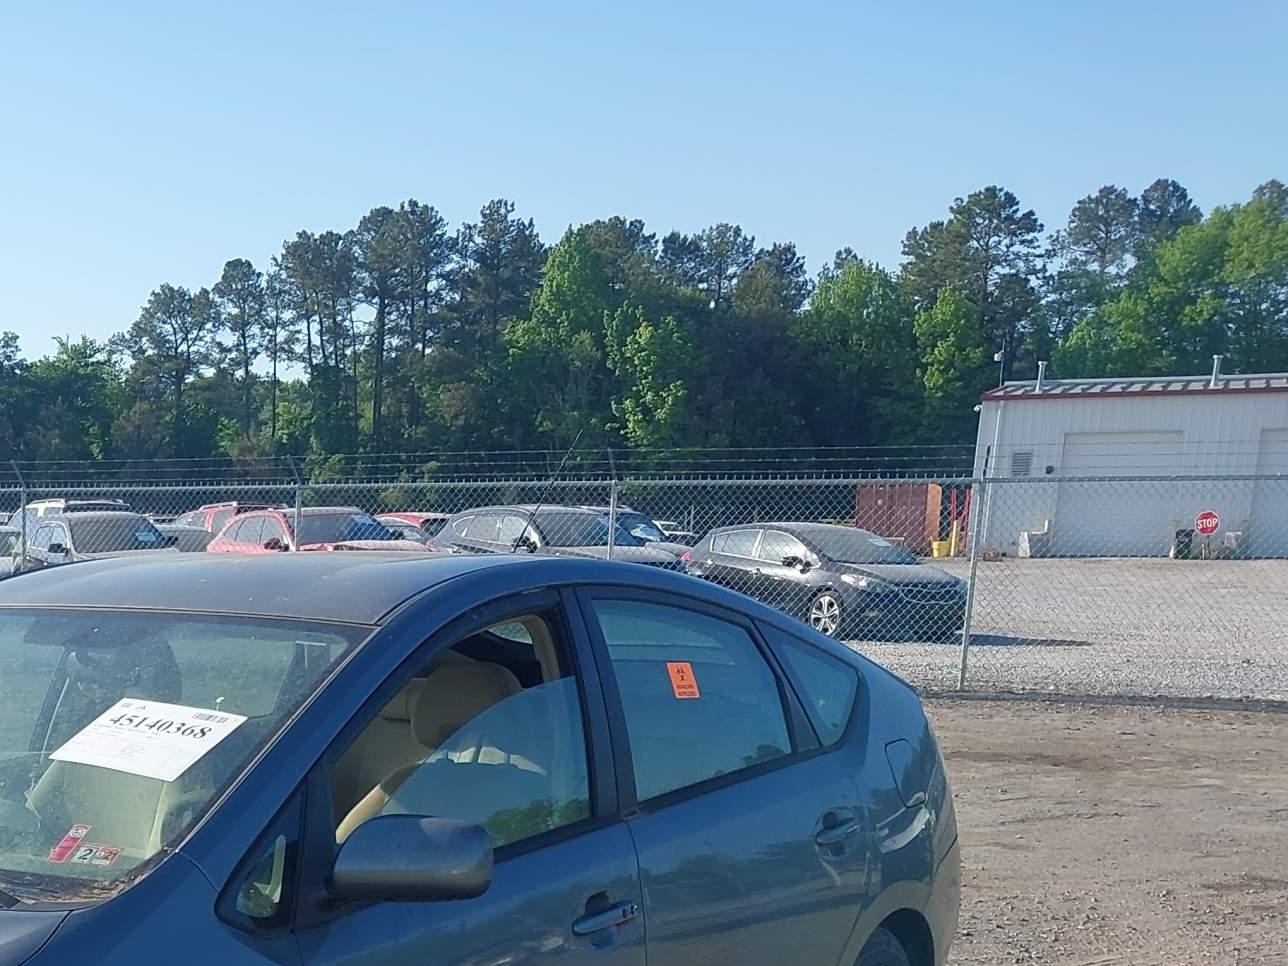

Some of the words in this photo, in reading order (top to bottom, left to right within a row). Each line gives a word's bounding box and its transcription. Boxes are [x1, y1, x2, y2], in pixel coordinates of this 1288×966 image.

[1197, 517, 1218, 529] STOP
[109, 713, 212, 739] 45140368
[77, 848, 94, 860] 2
